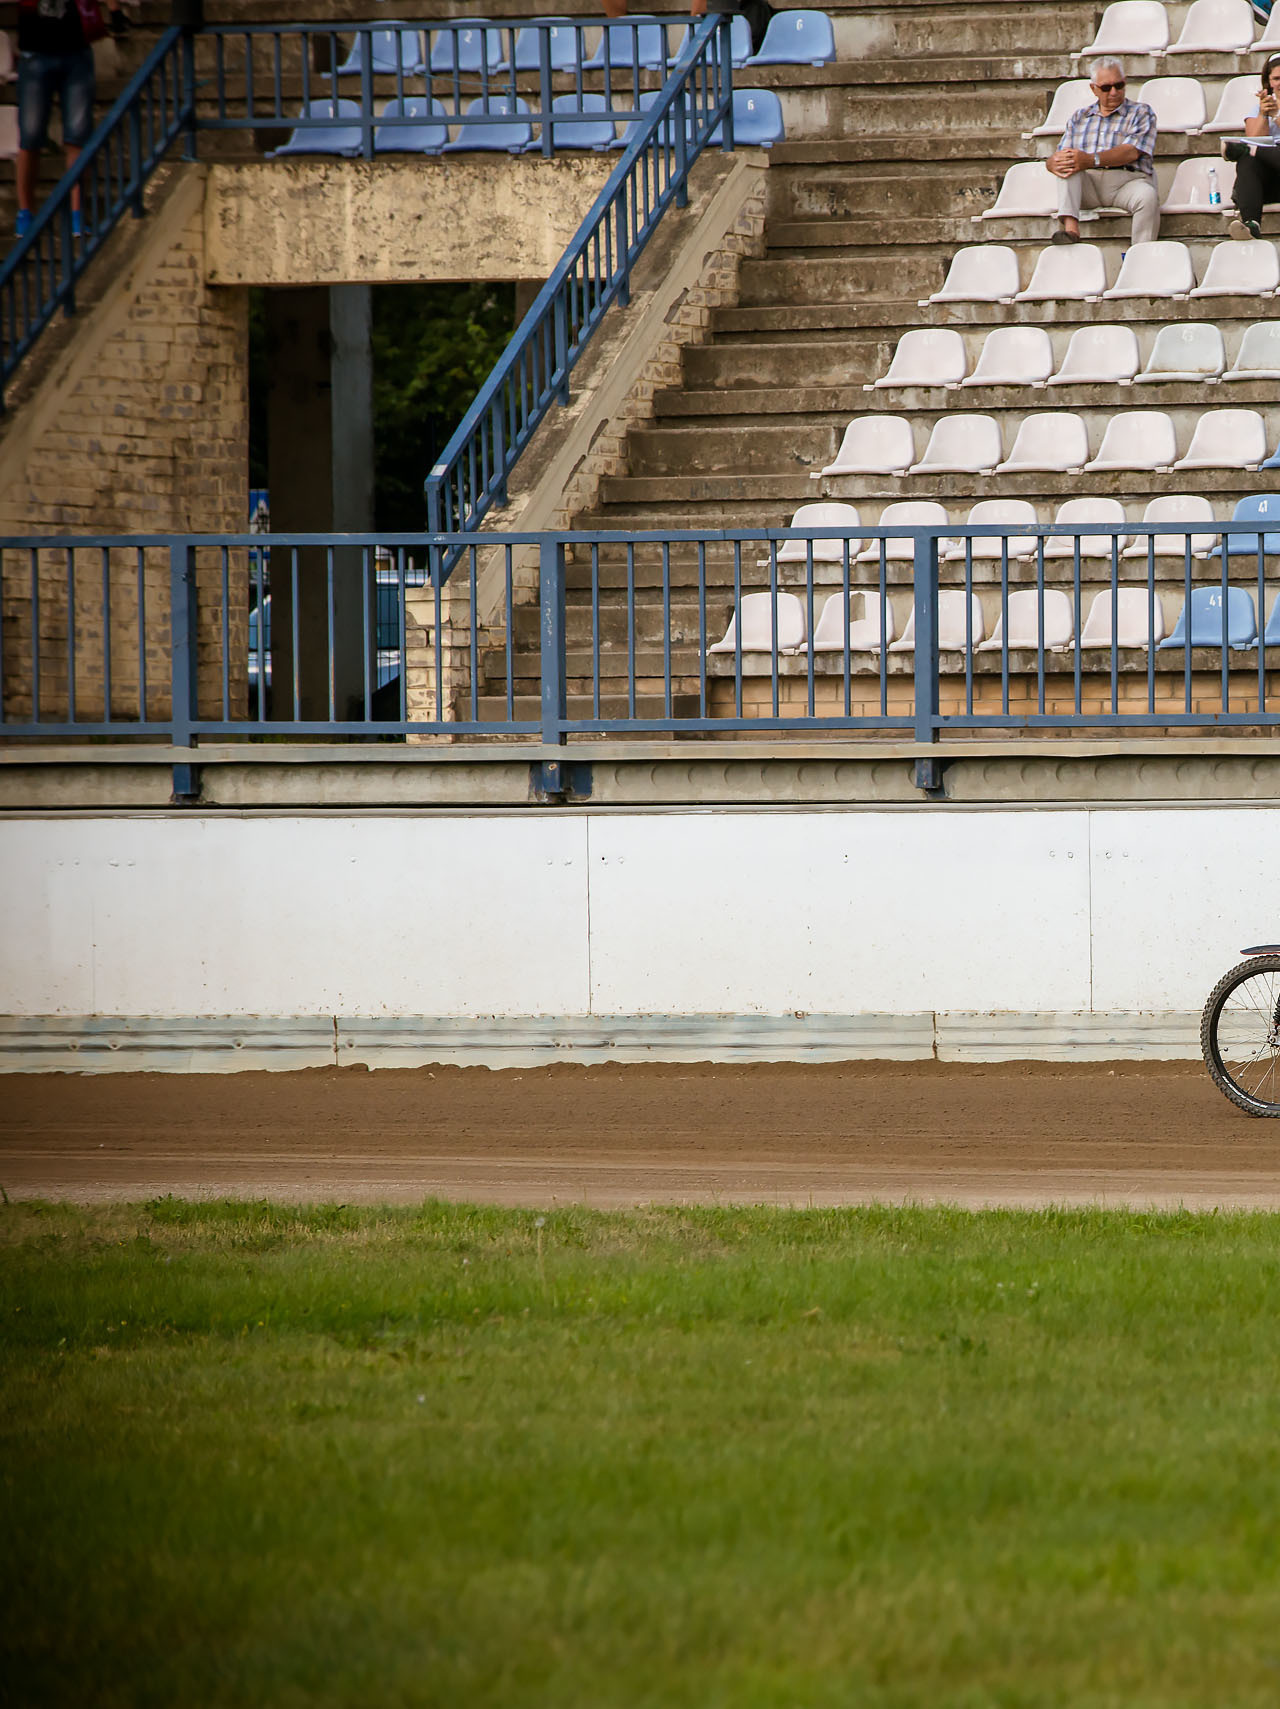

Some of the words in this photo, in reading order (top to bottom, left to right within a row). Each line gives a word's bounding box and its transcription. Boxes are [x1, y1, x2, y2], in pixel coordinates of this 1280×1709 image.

[796, 18, 804, 31] 6
[747, 99, 755, 111] 6
[1257, 499, 1268, 513] 41
[1209, 594, 1223, 608] 41
